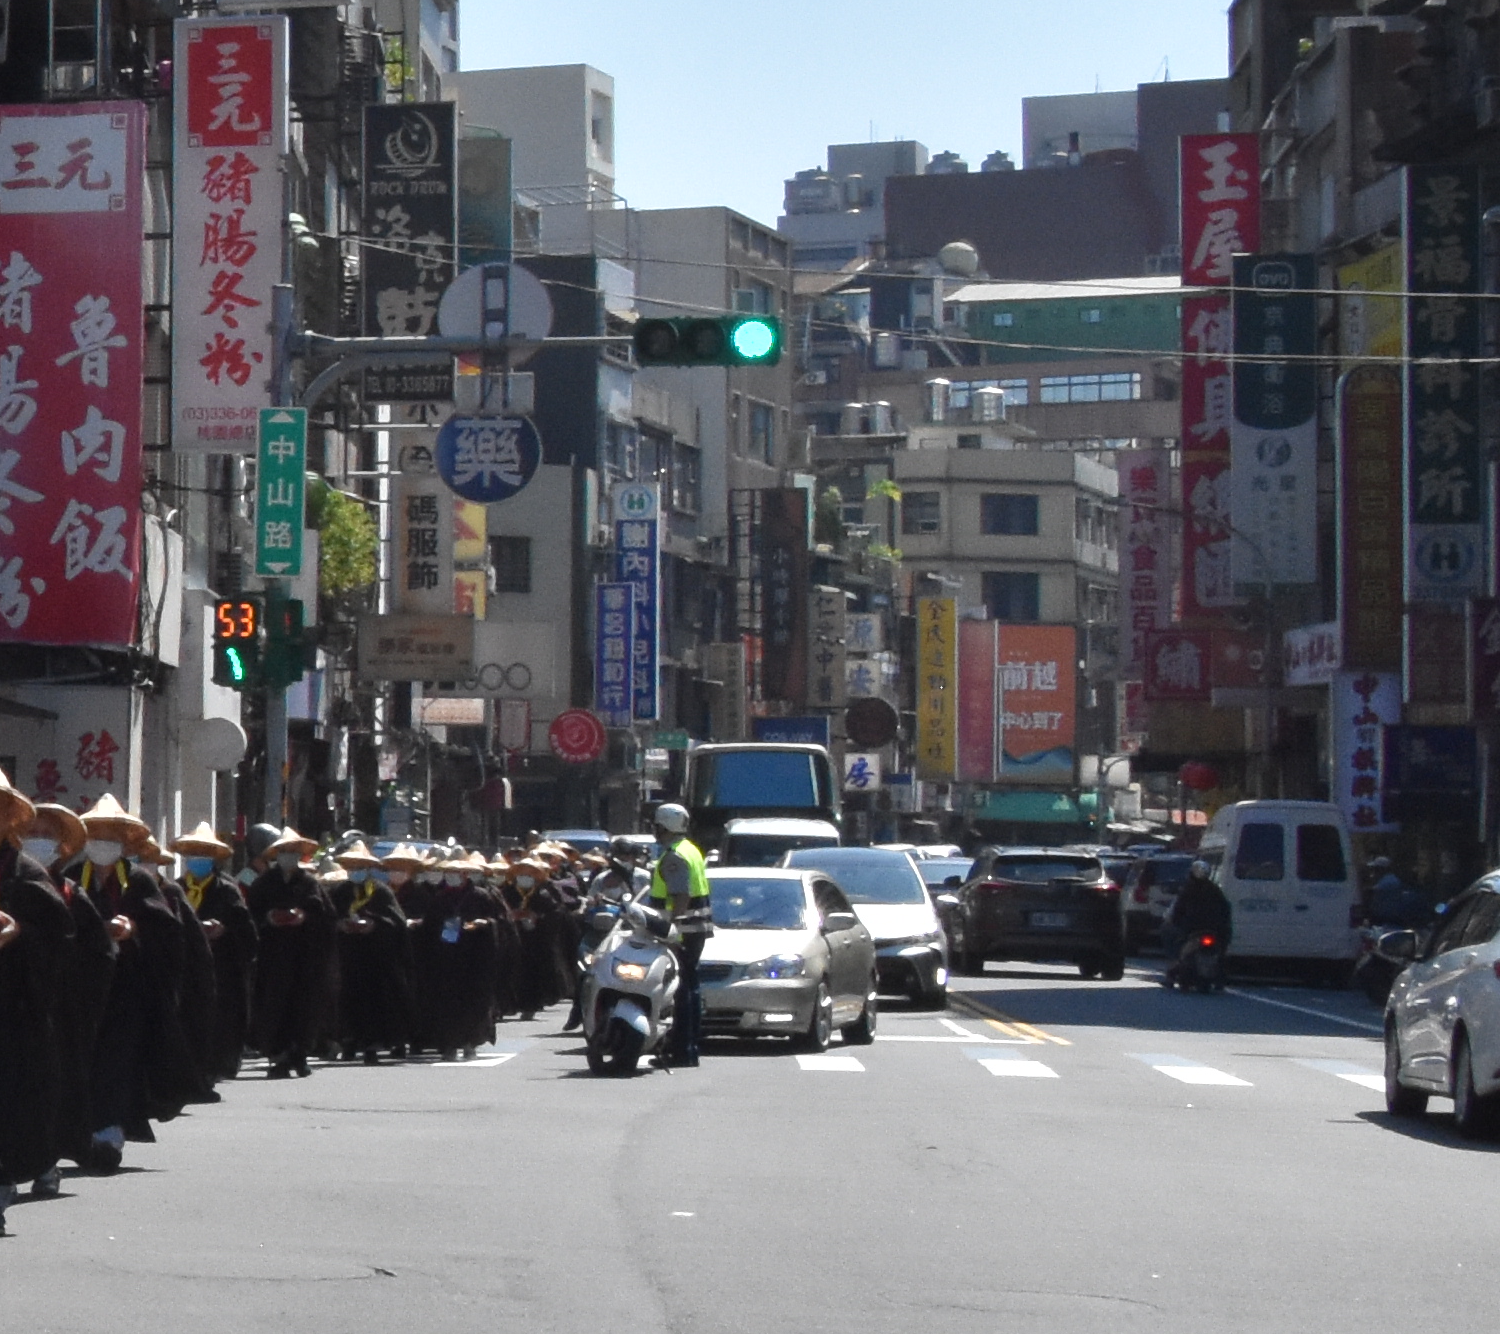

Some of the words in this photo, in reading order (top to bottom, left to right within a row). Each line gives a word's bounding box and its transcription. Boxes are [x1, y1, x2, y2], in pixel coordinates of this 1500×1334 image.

[207, 42, 261, 132] 三元
[0, 137, 111, 193] 三元
[370, 180, 405, 195] ROCK
[49, 294, 136, 582] 魯肉飯
[264, 434, 296, 549] 中山路
[217, 603, 254, 638] 53
